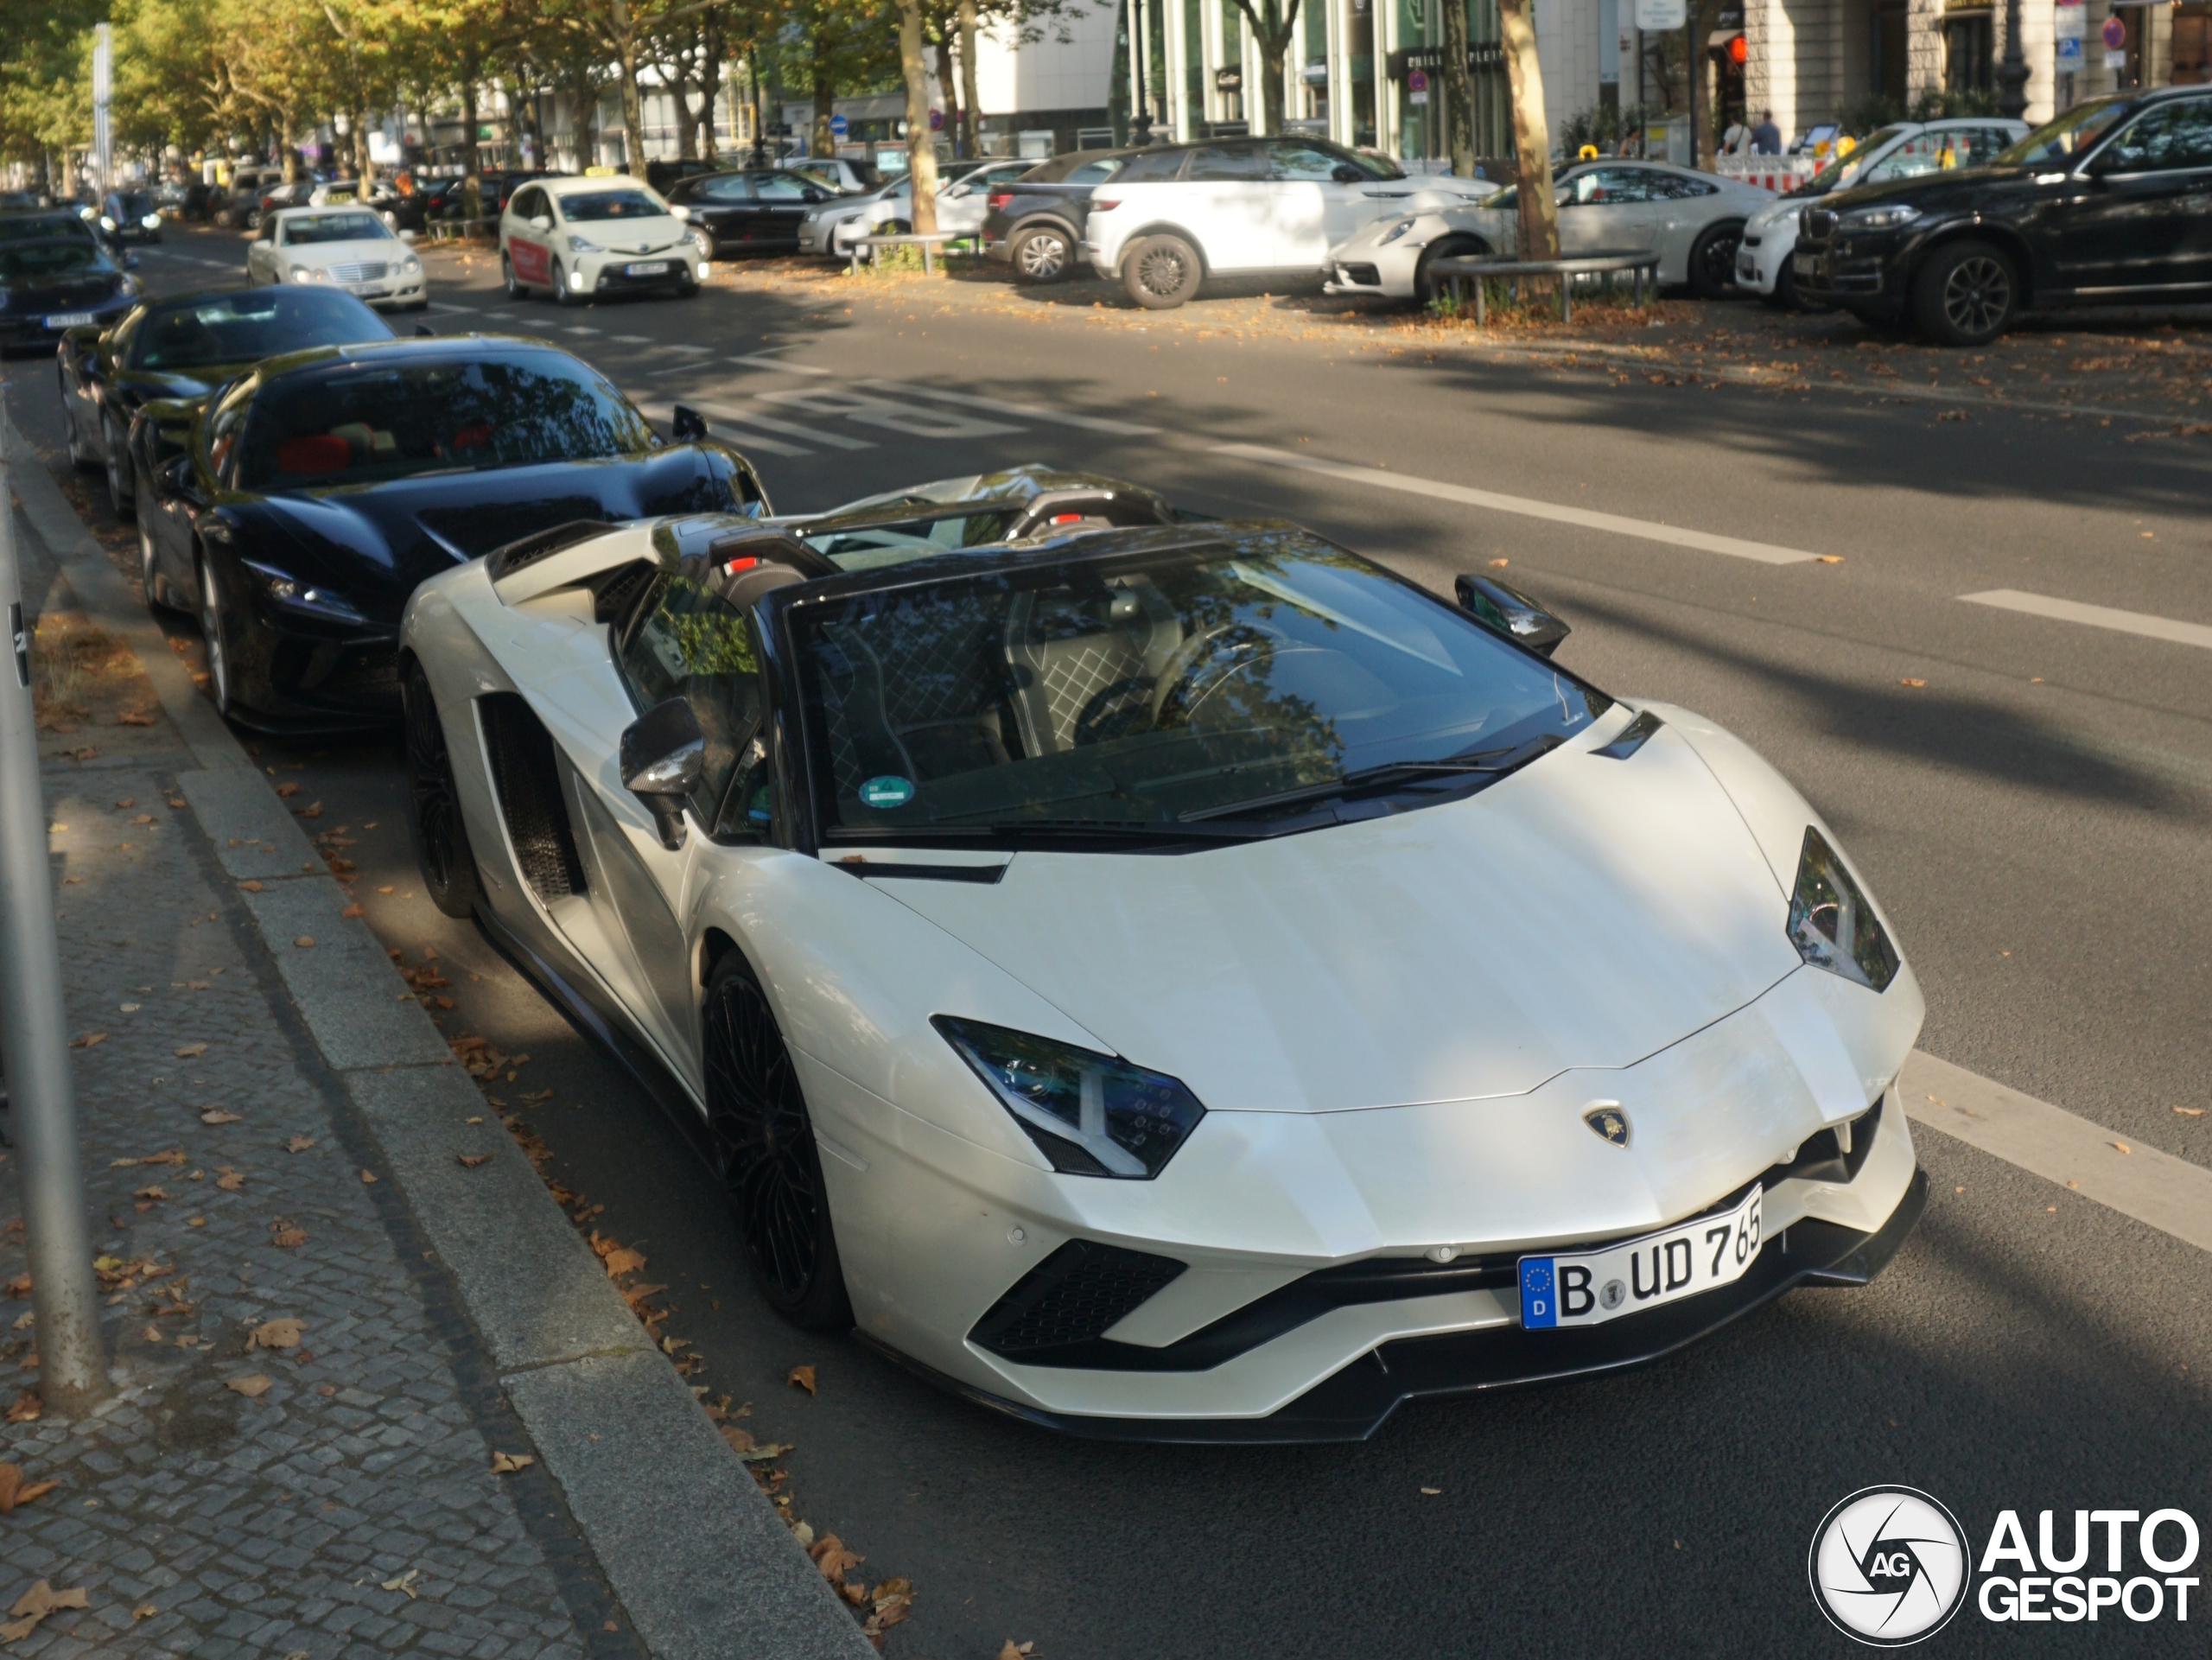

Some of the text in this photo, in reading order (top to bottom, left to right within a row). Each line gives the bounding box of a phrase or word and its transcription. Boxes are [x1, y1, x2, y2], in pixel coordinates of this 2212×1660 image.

[1408, 55, 1442, 67] PHILI
[880, 779, 893, 791] 4
[1559, 1265, 1596, 1317] B
[1631, 1237, 1692, 1300] UD
[1706, 1197, 1761, 1277] 765
[1534, 1301, 1547, 1316] D
